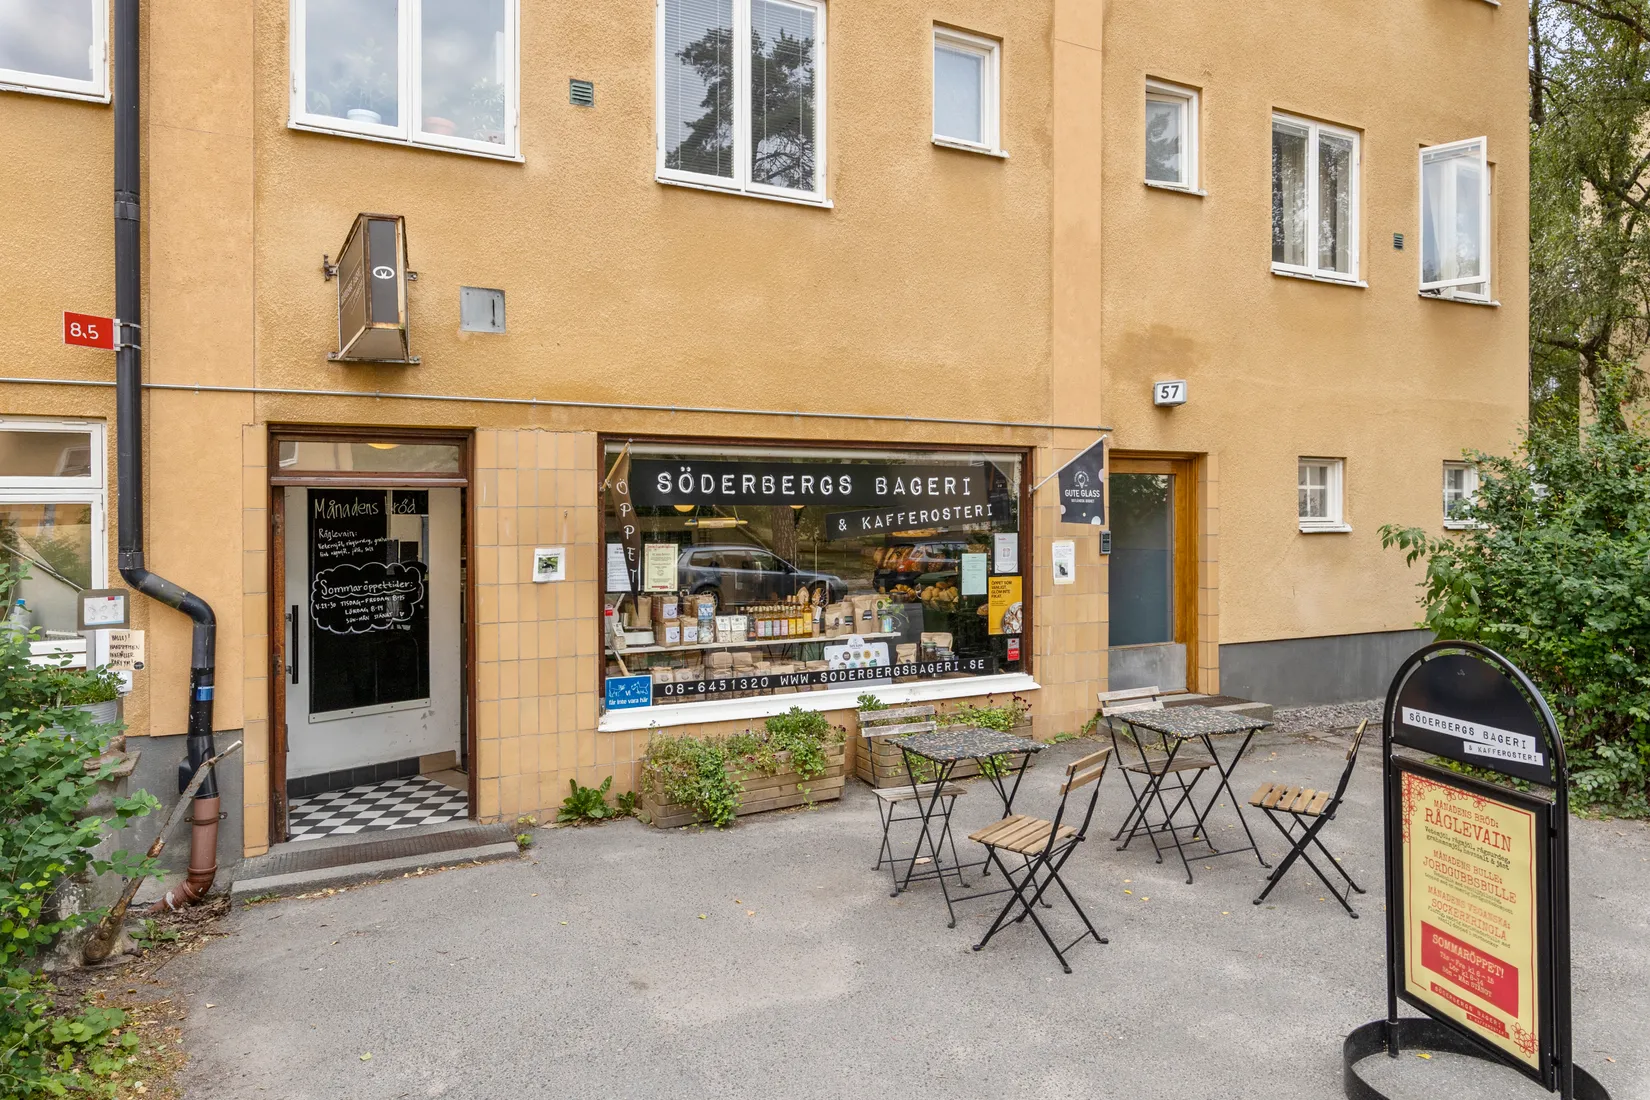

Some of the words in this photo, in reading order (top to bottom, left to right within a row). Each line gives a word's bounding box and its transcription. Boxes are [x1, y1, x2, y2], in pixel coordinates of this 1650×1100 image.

[70, 322, 99, 340] 8,5
[1160, 385, 1179, 399] 57
[657, 466, 852, 495] SÖDERBERGS
[875, 476, 971, 496] BAGERI
[1065, 489, 1080, 497] GUTE
[1081, 489, 1100, 498] GLASS
[314, 497, 379, 519] Månadens
[838, 518, 847, 532] &
[861, 503, 993, 531] KAFFEROSTERI
[615, 478, 638, 583] ÖPPET
[320, 579, 413, 596] Sommaröppettider:
[665, 676, 769, 695] 08-6451320
[1409, 712, 1475, 736] SÖDERBERGS
[1483, 731, 1527, 750] BAGERI
[1477, 746, 1538, 762] KAFFEROSTERI
[1434, 799, 1471, 818] MÅNADENS
[1474, 813, 1498, 828] BRÖD:
[1425, 807, 1510, 851] RÅGLEVAIN
[1423, 856, 1515, 903] JORDGUBBSBULLE
[1433, 849, 1470, 871] MÅNADENS
[1473, 865, 1502, 884] BULLE:
[1428, 885, 1464, 908] MÅNADENS
[1467, 903, 1510, 929] VEGANSKA:
[1431, 898, 1505, 940] SOCKERKRINGLA
[1431, 931, 1504, 979] SOMMARÖPPET!
